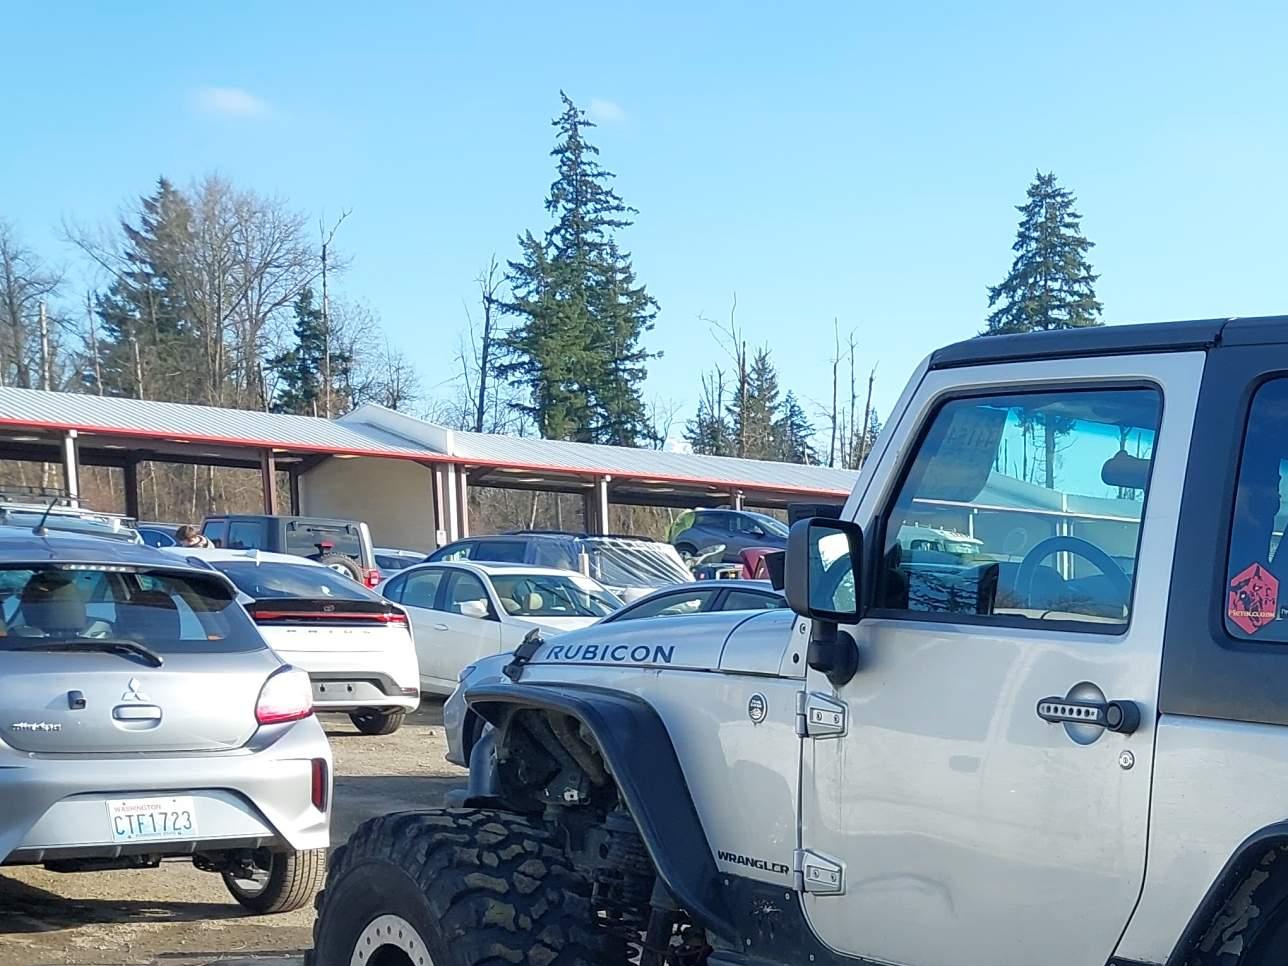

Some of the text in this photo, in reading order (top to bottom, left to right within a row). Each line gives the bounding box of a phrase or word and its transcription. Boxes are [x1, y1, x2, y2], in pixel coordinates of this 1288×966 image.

[546, 644, 675, 664] RUBICON
[114, 811, 192, 836] CTF1723
[717, 849, 790, 875] WRANGLER
